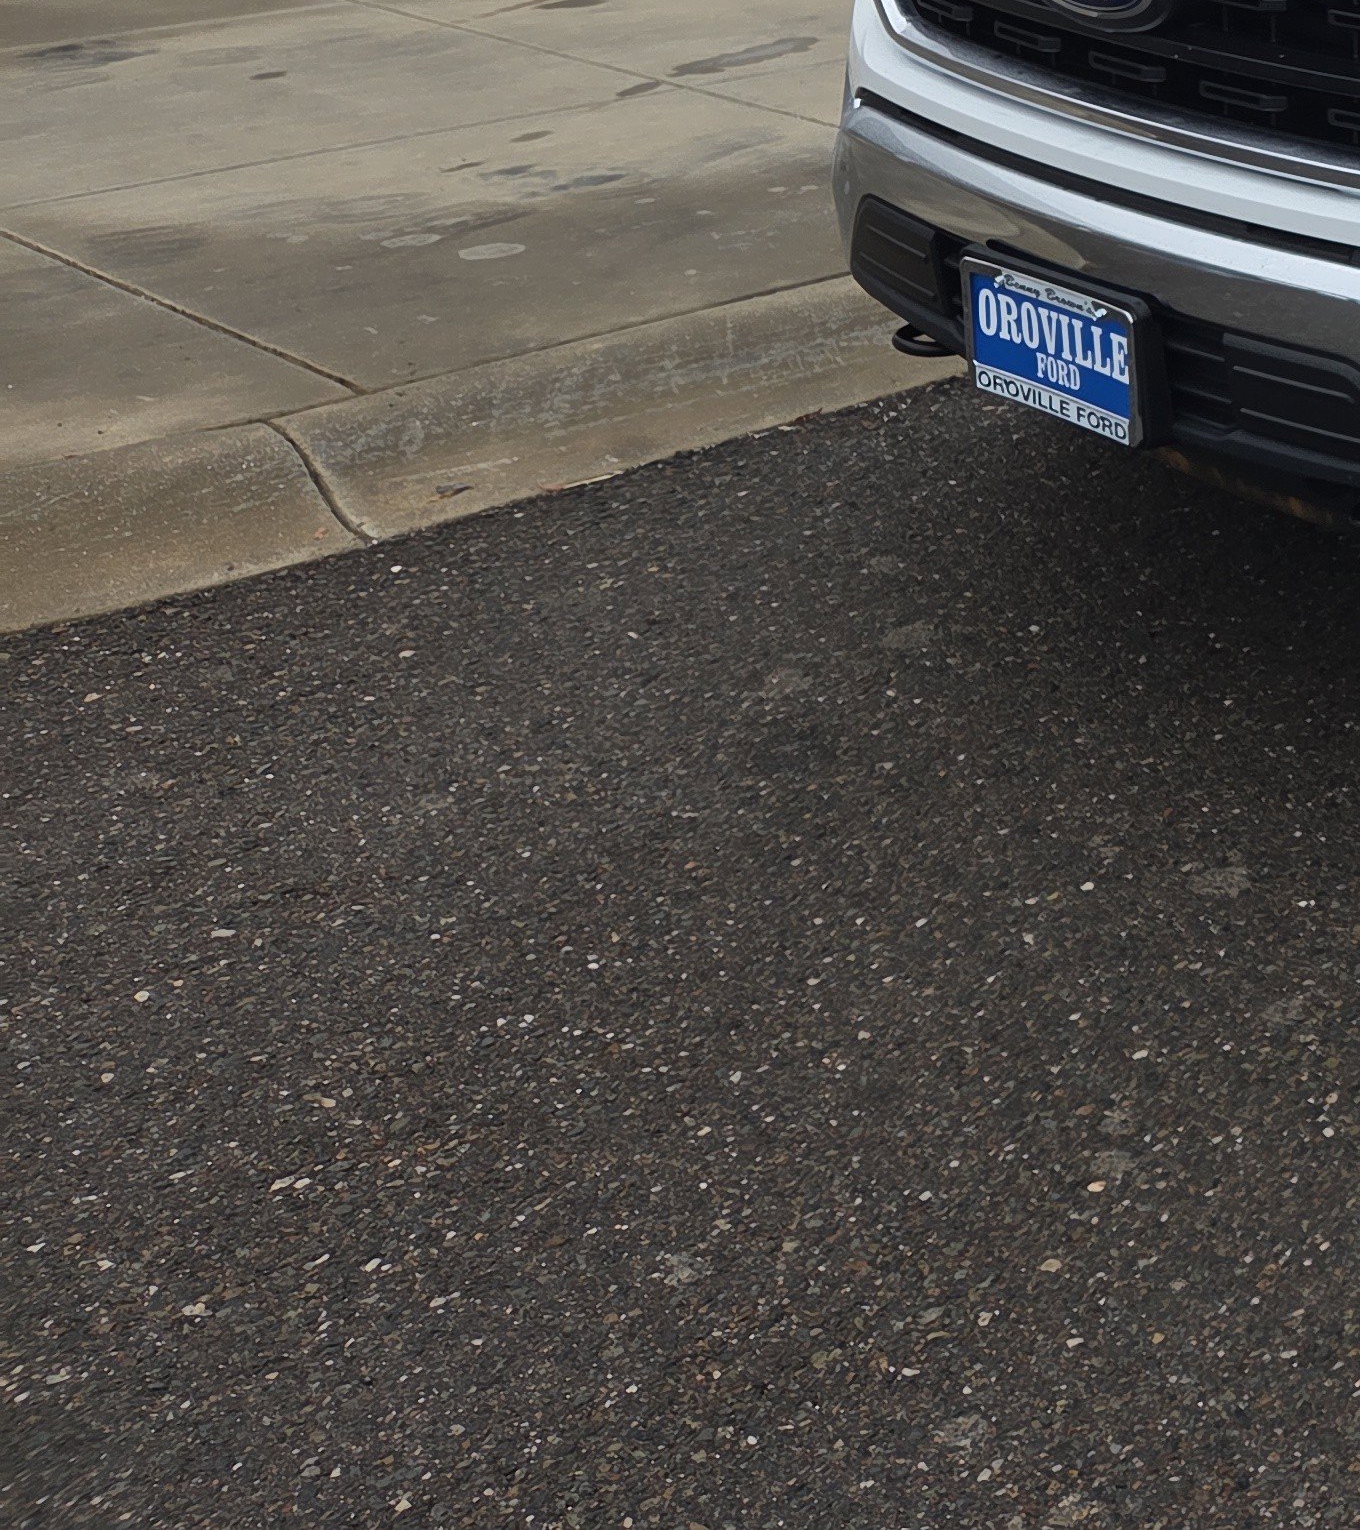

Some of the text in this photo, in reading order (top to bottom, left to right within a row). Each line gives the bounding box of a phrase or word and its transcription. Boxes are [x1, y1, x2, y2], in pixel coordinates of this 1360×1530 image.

[978, 288, 1130, 385] OROVILLE
[1036, 352, 1081, 391] FORD
[977, 370, 1128, 441] OROVILLE FORD
